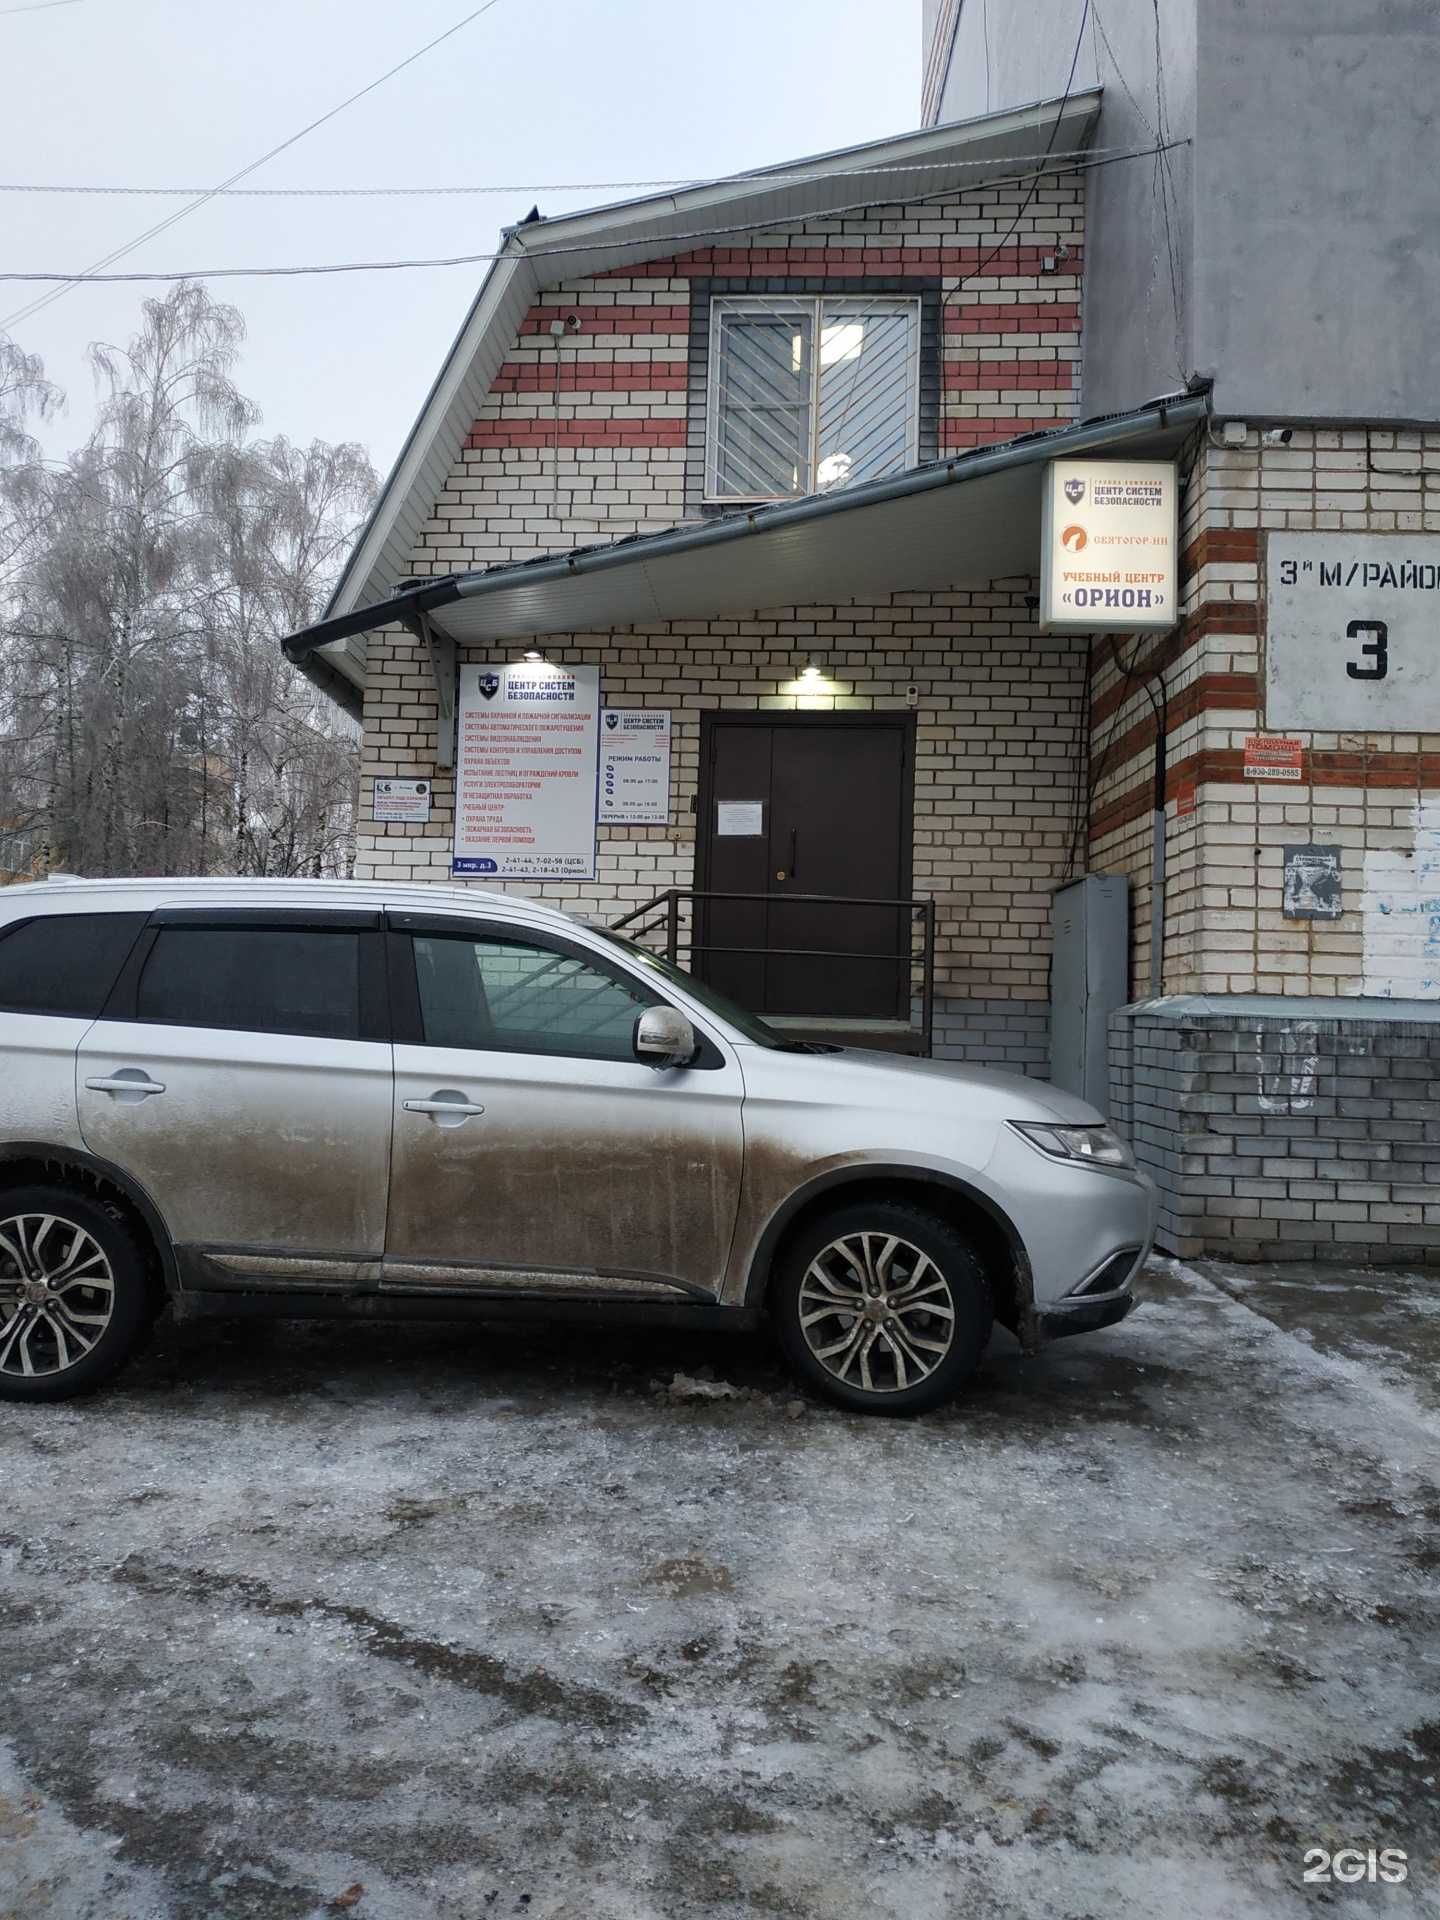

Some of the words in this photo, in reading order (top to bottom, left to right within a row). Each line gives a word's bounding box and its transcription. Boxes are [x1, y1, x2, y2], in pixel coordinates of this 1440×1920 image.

[1094, 487, 1124, 497] ЦЕНТР
[1126, 487, 1162, 496] СИСТЕМ
[1094, 497, 1162, 506] БЕЗОПАСНОСТИ
[1063, 570, 1121, 583] УЧЕБНЫЙ
[1125, 573, 1165, 585] ЦЕНТР
[1320, 560, 1440, 590] М/РАЙО
[1062, 588, 1164, 608] «ОРИОН»
[1346, 620, 1388, 681] 3
[508, 681, 537, 691] ЦЕНТР
[539, 682, 575, 690] СИСТЕМ
[508, 691, 575, 701] БЕЗОПАСНОСТИ
